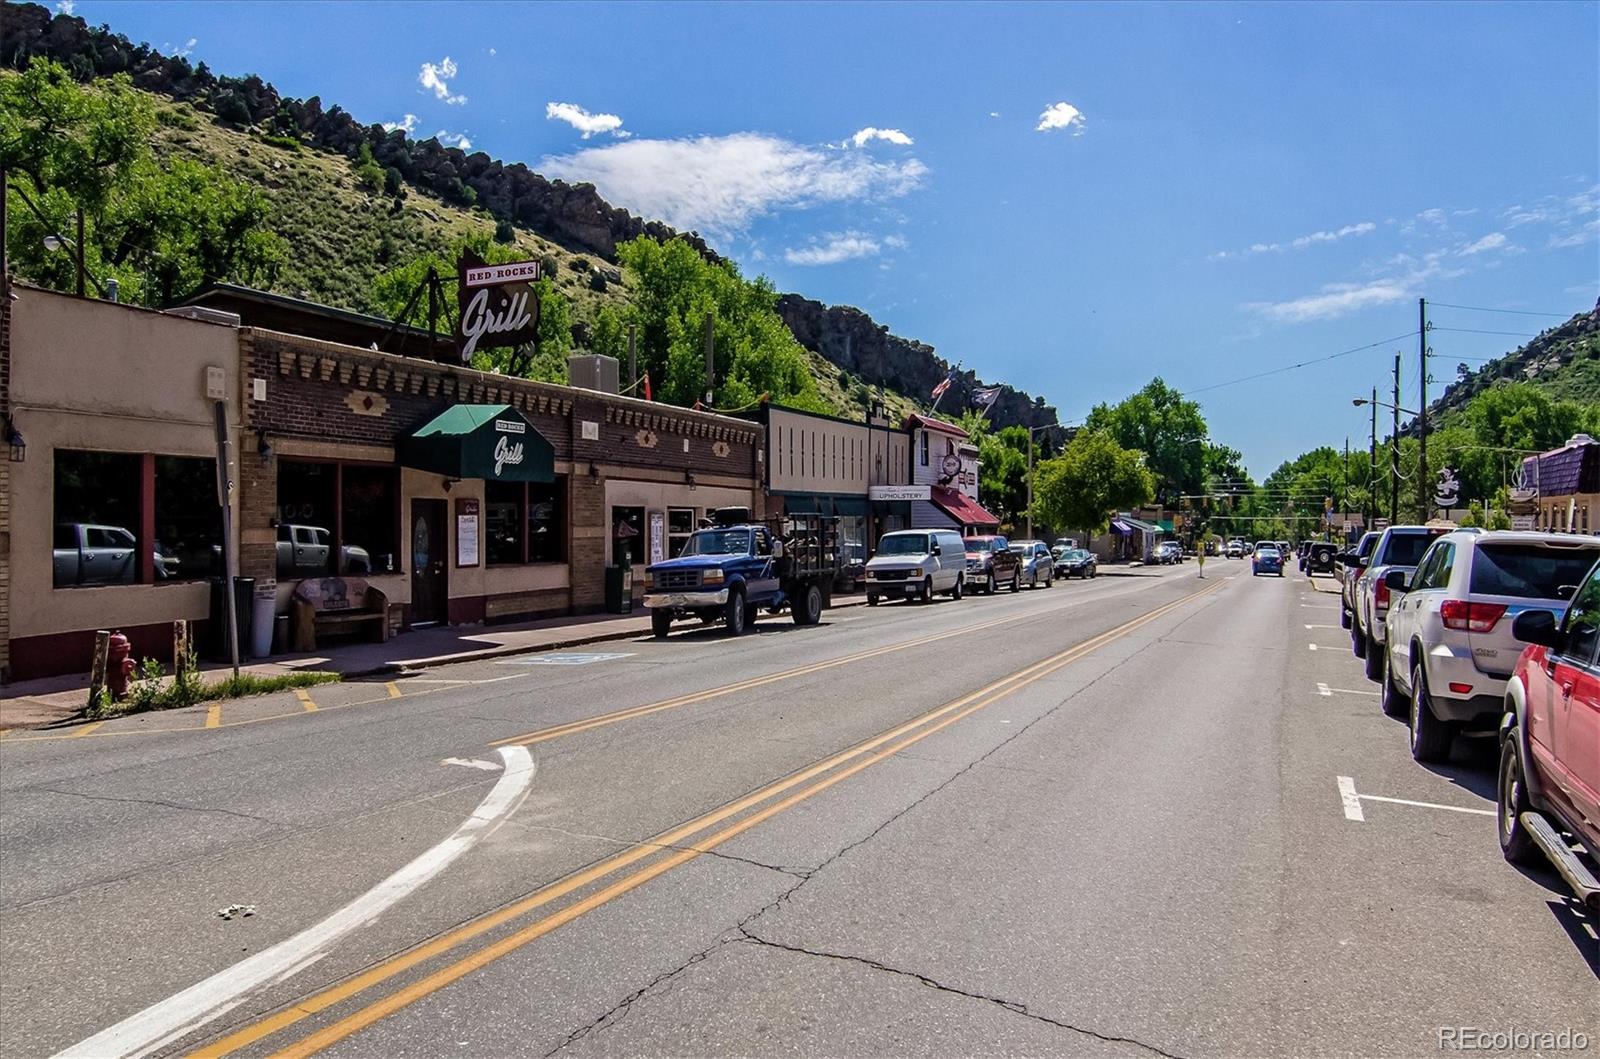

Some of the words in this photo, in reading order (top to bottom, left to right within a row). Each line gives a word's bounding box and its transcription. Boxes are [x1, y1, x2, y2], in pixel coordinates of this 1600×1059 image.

[469, 271, 492, 282] RED
[497, 266, 534, 278] ROCKS
[462, 288, 531, 362] Grill
[494, 436, 523, 476] Grill
